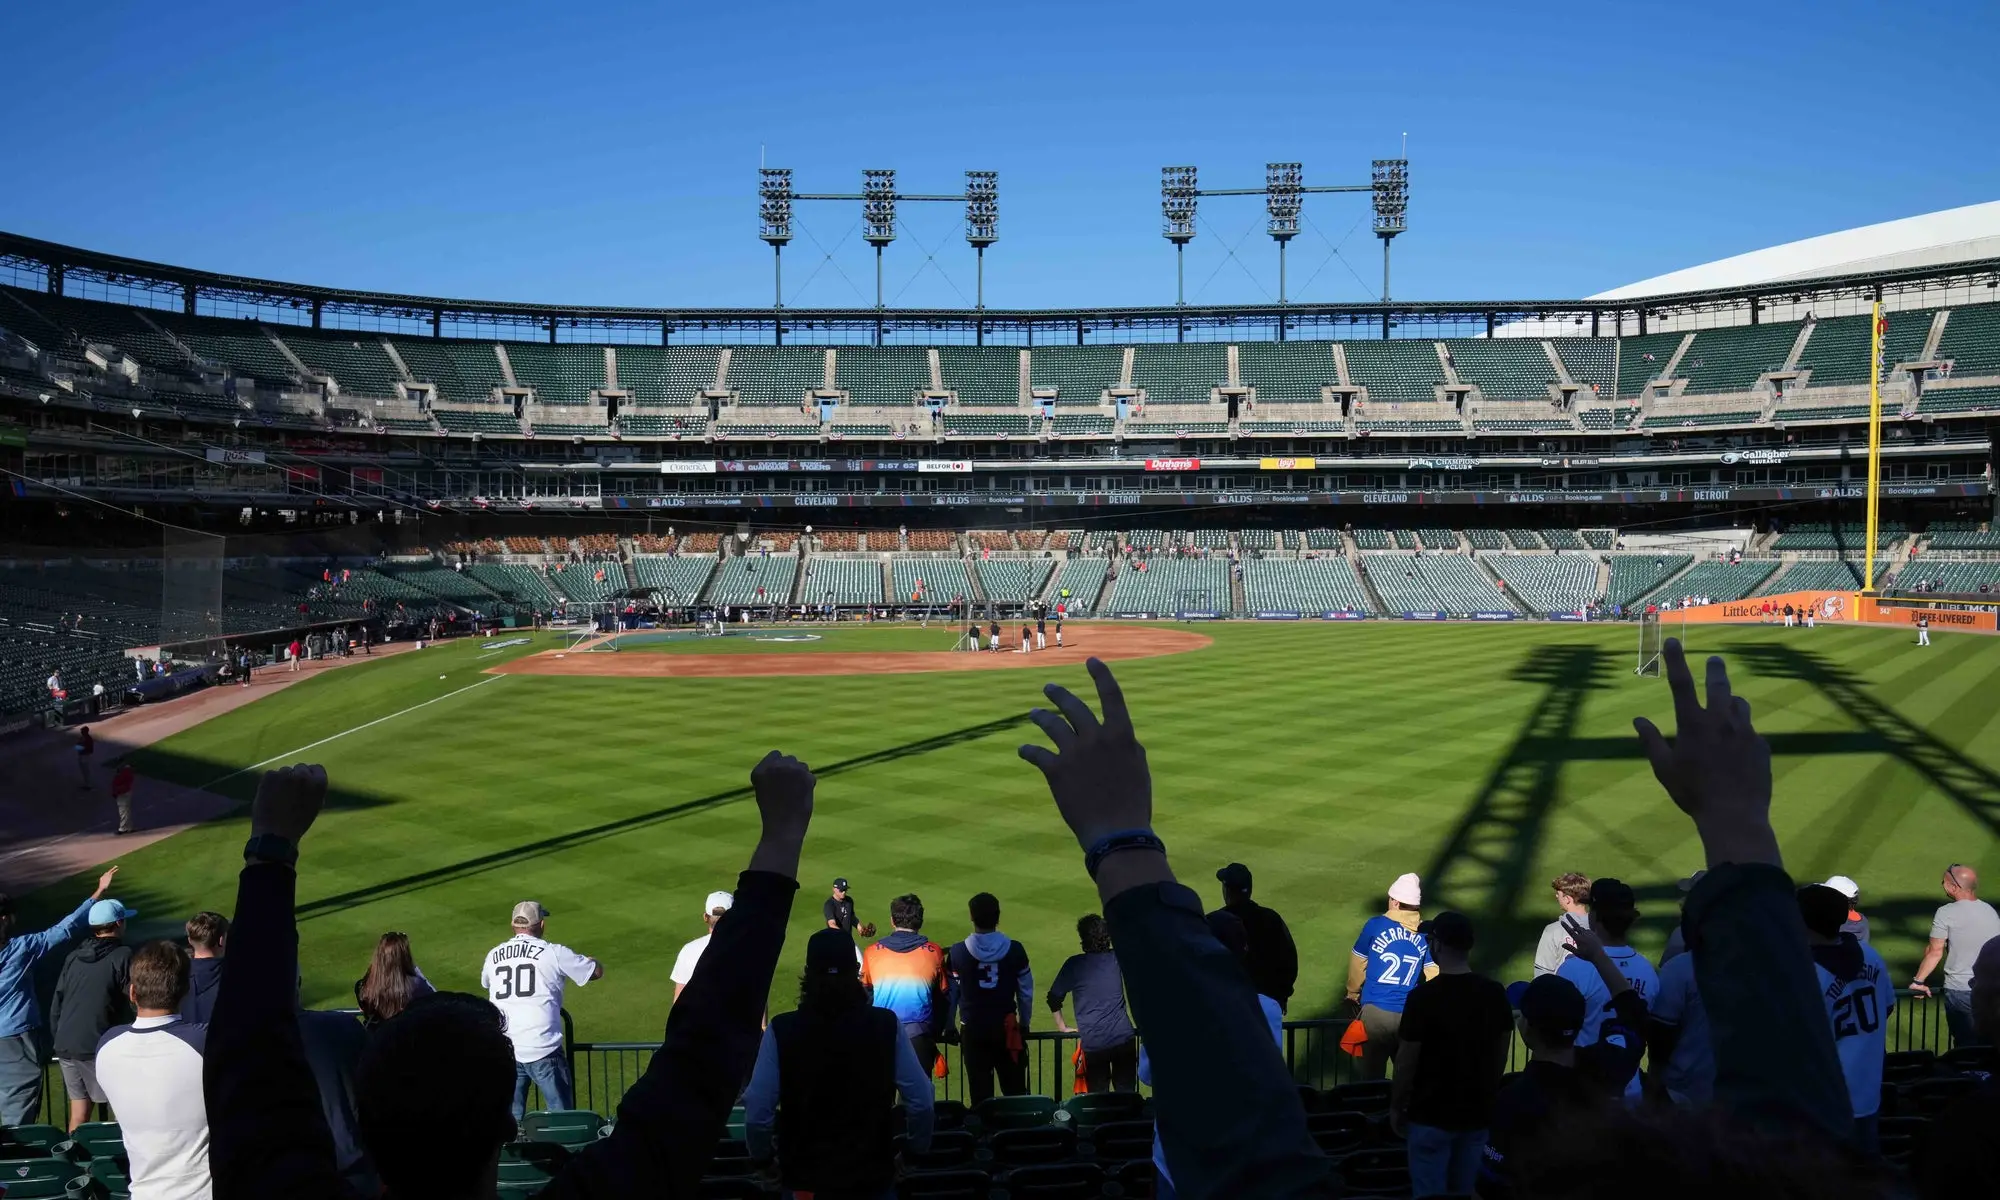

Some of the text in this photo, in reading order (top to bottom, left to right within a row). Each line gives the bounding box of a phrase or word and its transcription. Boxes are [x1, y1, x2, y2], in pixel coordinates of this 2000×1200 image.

[1742, 450, 1789, 459] Gallagher
[1435, 458, 1480, 466] CHAMPIONS
[1694, 490, 1730, 500] DETROIT
[1833, 488, 1863, 497] ALDS
[795, 496, 838, 506] CLEVELAND
[946, 496, 970, 505] ALDS
[1109, 495, 1141, 504] DETROIT
[1228, 495, 1252, 503] ALDS
[1272, 495, 1309, 503] Booking.com
[1363, 494, 1407, 503] CLEVELAND
[1520, 494, 1545, 502] ALDS
[1723, 605, 1748, 617] Little
[1371, 927, 1422, 954] GUERRERO
[493, 940, 544, 964] ORDOÑEZ
[1377, 952, 1420, 986] 27
[979, 962, 999, 989] 3
[495, 963, 536, 1000] 30
[1826, 963, 1880, 1000] TORSON
[1833, 986, 1878, 1042] 20
